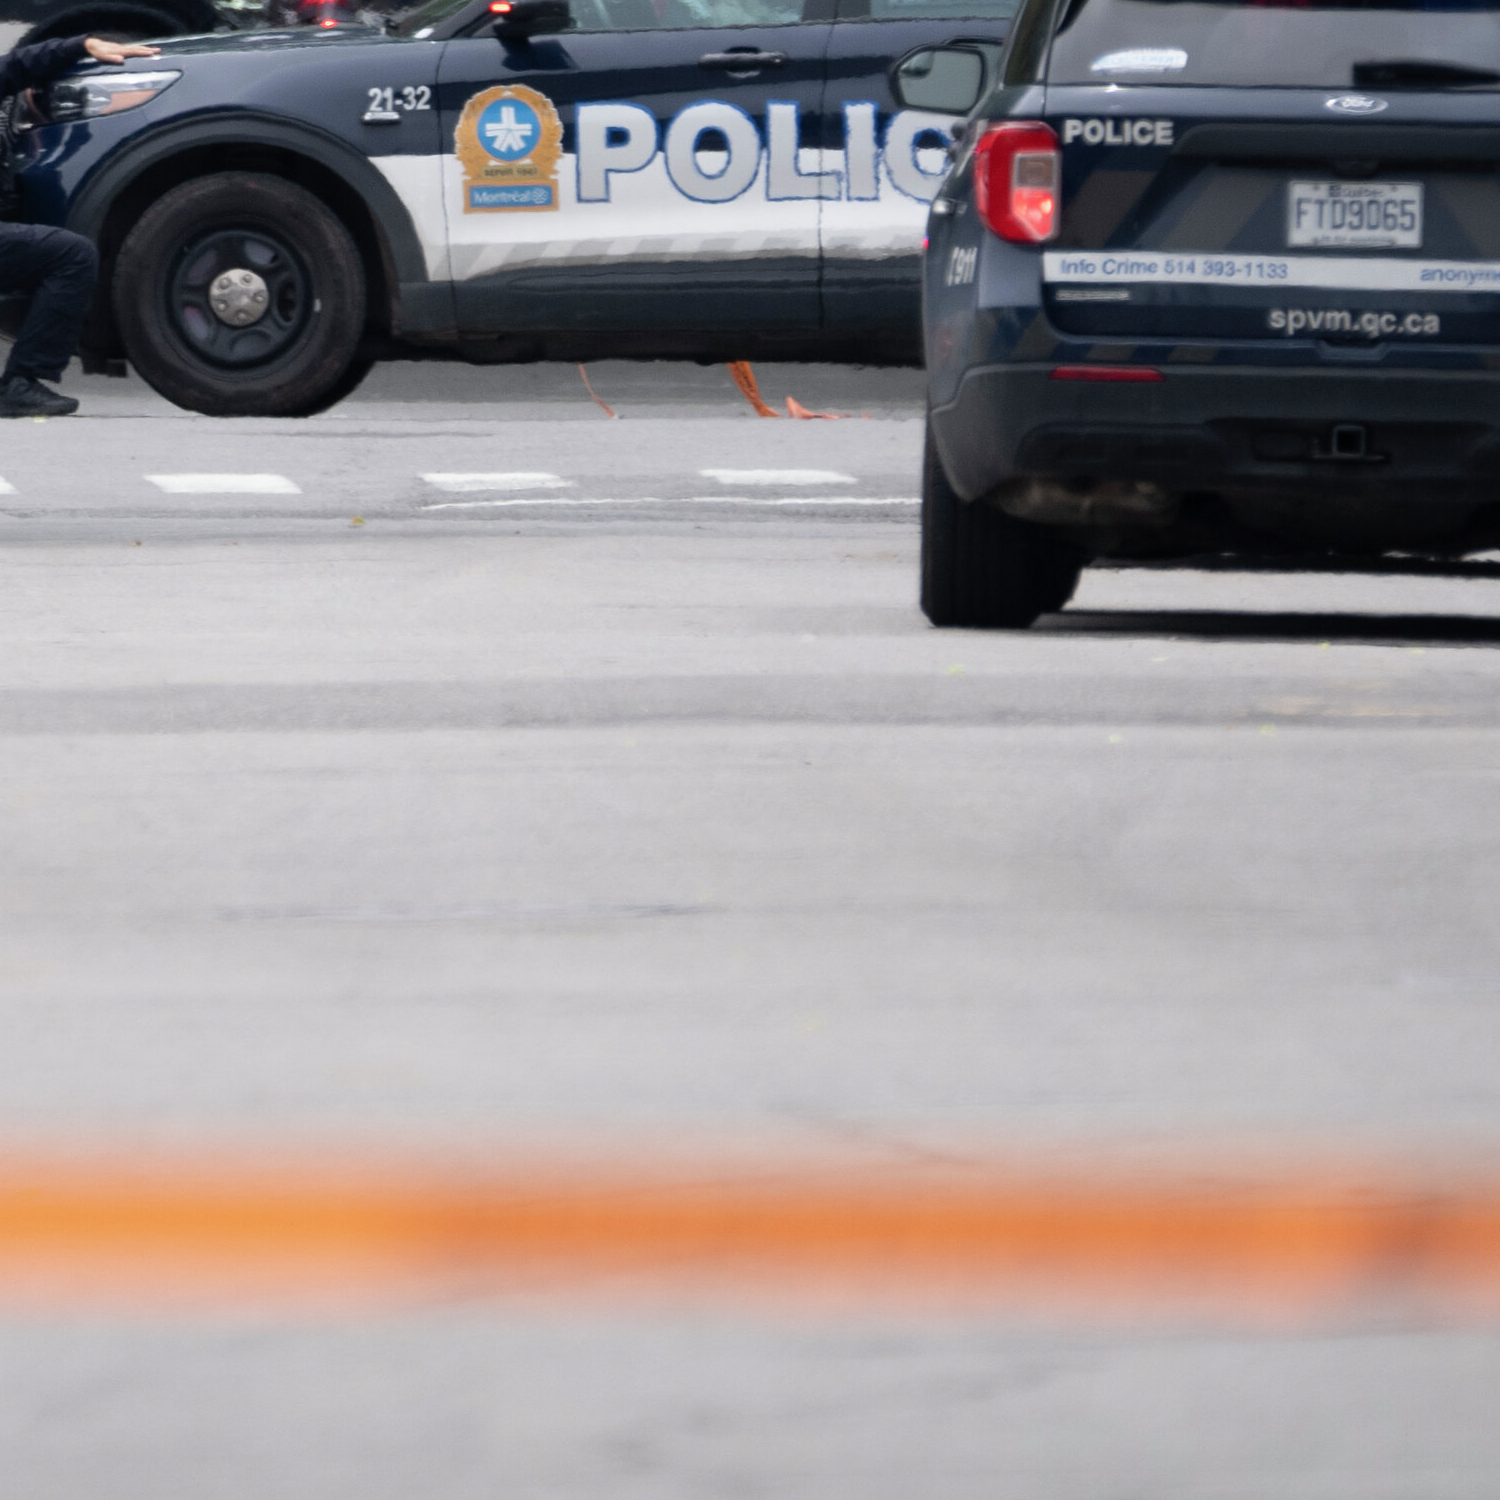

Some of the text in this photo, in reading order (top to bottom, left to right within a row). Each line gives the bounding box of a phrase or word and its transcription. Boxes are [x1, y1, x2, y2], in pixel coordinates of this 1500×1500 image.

[368, 86, 432, 111] 21-32
[1064, 119, 1174, 145] POLICE
[575, 100, 962, 203] POLIC
[1296, 198, 1416, 231] FTD9065
[1061, 259, 1288, 280] Info Crime 514 393-1133
[1269, 308, 1441, 337] spvm.qc.ca
